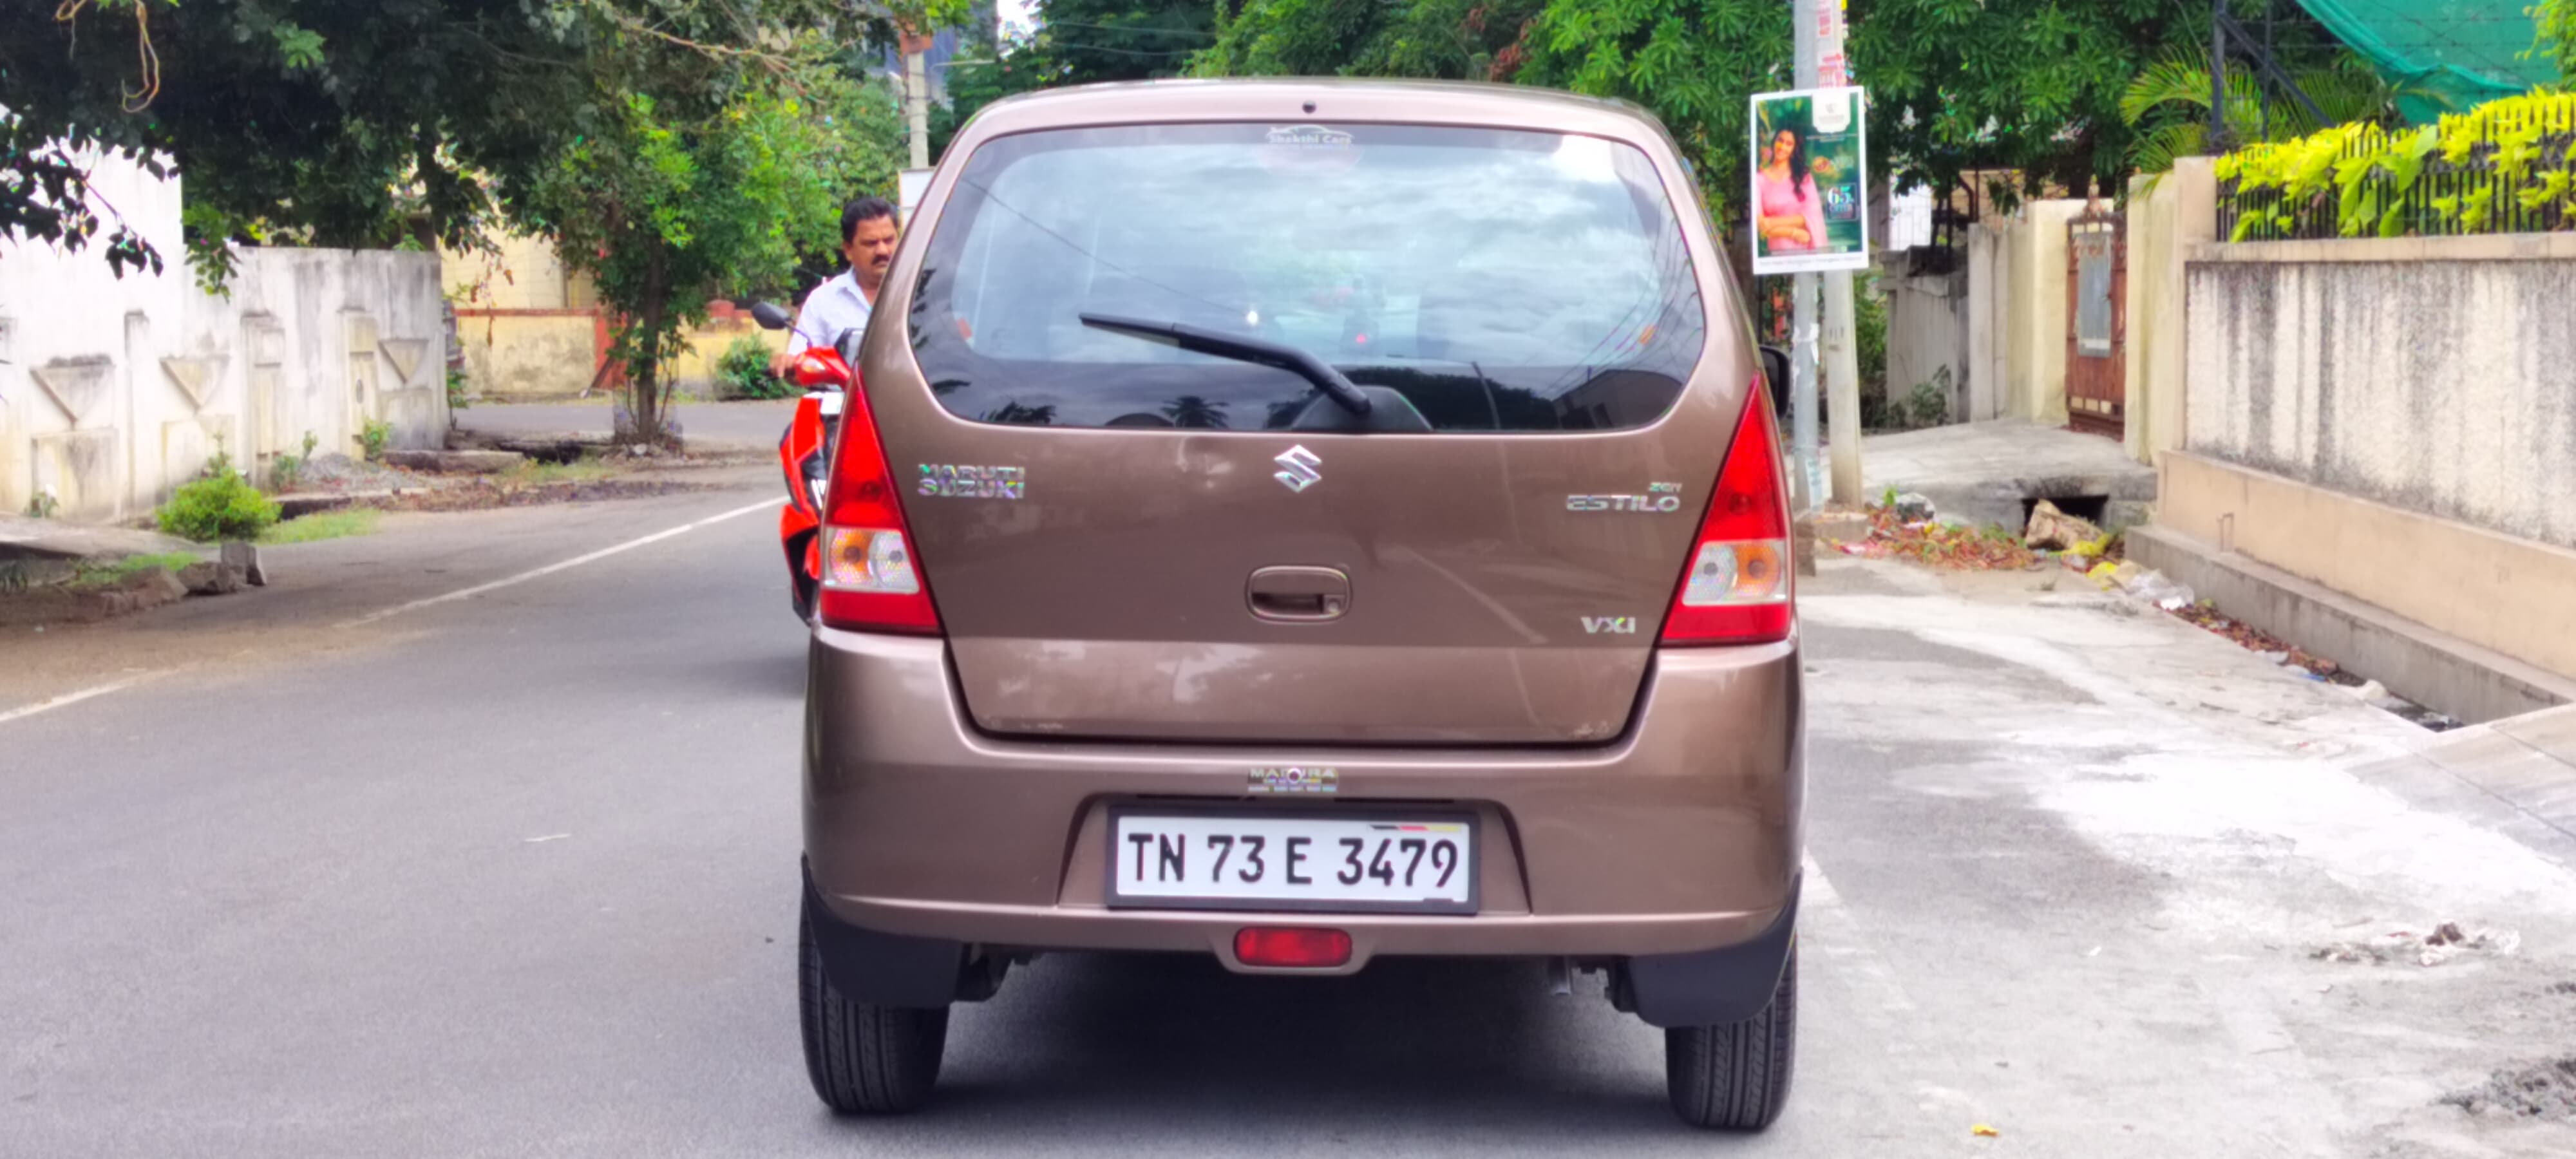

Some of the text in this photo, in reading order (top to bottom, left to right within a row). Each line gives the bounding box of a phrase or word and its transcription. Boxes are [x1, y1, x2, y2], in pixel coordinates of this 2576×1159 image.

[918, 464, 1025, 480] MARUTI
[918, 478, 1025, 498] SUZUKI
[1649, 482, 1682, 492] ZEN
[1566, 495, 1680, 512] ESTILO
[1128, 833, 1458, 887] TN 73 E 3479
